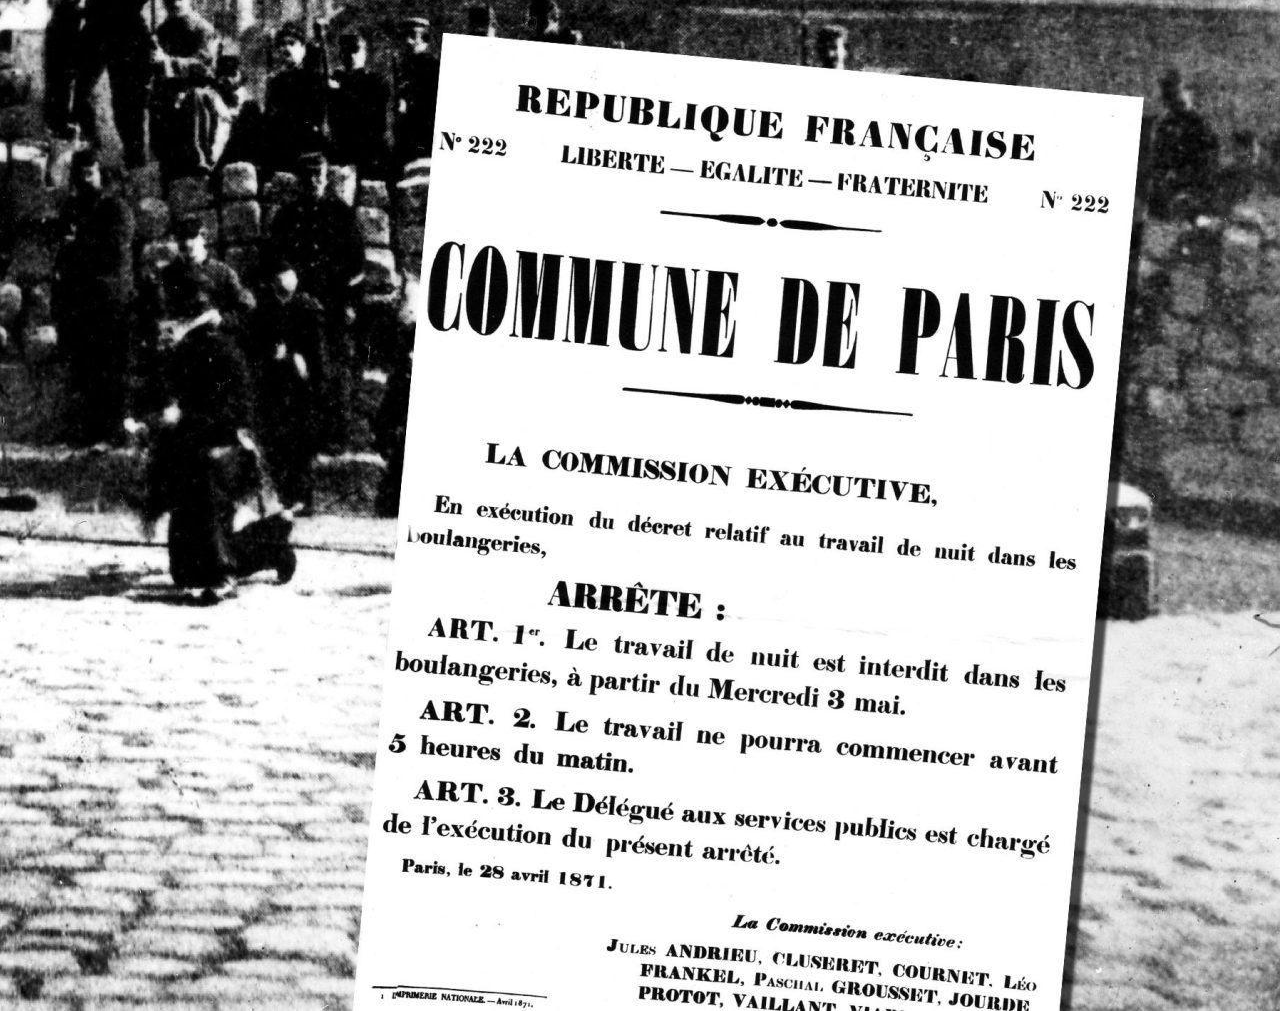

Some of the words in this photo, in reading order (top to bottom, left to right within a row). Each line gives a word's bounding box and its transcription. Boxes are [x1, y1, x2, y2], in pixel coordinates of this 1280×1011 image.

[468, 135, 507, 157] 222
[515, 84, 784, 143] REPUBLIQUE
[804, 114, 1035, 162] FRANÇAISE
[560, 144, 665, 175] LIBERTE
[699, 160, 803, 188] EGALITE
[837, 172, 988, 204] FRATERNITE
[1071, 194, 1110, 214] 222
[427, 241, 739, 359] COMMUNE
[773, 276, 861, 370] DE
[895, 286, 1095, 390] PARIS
[485, 442, 526, 467] LA
[541, 449, 733, 487] COMMISSION
[746, 466, 938, 507] EXÉCUTIVE,
[433, 494, 463, 515] En
[476, 502, 574, 527] exécution
[588, 510, 614, 530] du
[627, 514, 692, 537] décret
[705, 522, 770, 544] relatif
[779, 533, 805, 547] au
[819, 533, 884, 554] travail
[896, 538, 922, 557] de
[934, 543, 976, 562] nuit
[987, 546, 1036, 567] dans
[1049, 550, 1077, 571] les
[547, 580, 702, 620] ARRÊTE
[395, 650, 558, 688] boulangeries,
[566, 666, 583, 687] à
[589, 673, 661, 696] partir
[669, 674, 700, 698] du
[707, 677, 820, 708] Mercredi
[827, 689, 845, 710] 3
[854, 694, 906, 716] mai.
[427, 617, 499, 643] ART.
[564, 628, 598, 652] Le
[614, 635, 694, 660] travail
[705, 641, 735, 663] de
[750, 648, 800, 669] nuit
[812, 654, 846, 673] est
[858, 655, 949, 683] interdit
[963, 663, 1020, 689] dans
[1034, 669, 1066, 693] les
[388, 733, 407, 754] 5
[419, 734, 501, 761] heures
[513, 743, 544, 765] du
[556, 752, 634, 774] matin.
[419, 699, 495, 725] ART.
[513, 707, 536, 729] 2.
[554, 710, 589, 734] Le
[603, 717, 684, 742] travail
[696, 729, 726, 745] ne
[740, 733, 822, 755] pourra
[836, 741, 976, 767] commencer
[989, 755, 1058, 774] avant
[382, 812, 412, 835] de
[421, 815, 552, 846] l'exécution
[561, 827, 592, 849] du
[605, 835, 693, 858] présent
[702, 843, 780, 865] arrêté.
[413, 779, 489, 805] ART.
[497, 786, 521, 807] 3.
[531, 788, 566, 811] Le
[572, 791, 674, 824] Délégué
[681, 809, 726, 825] aux
[734, 811, 826, 833] services
[834, 817, 917, 841] publics
[924, 827, 958, 845] est
[966, 827, 1051, 858] chargé
[401, 858, 451, 877] Paris,
[458, 862, 473, 877] le
[479, 864, 505, 880] 28
[510, 869, 550, 884] avril
[559, 871, 612, 890] 1871.
[731, 914, 759, 930] La
[765, 917, 867, 939] Commission
